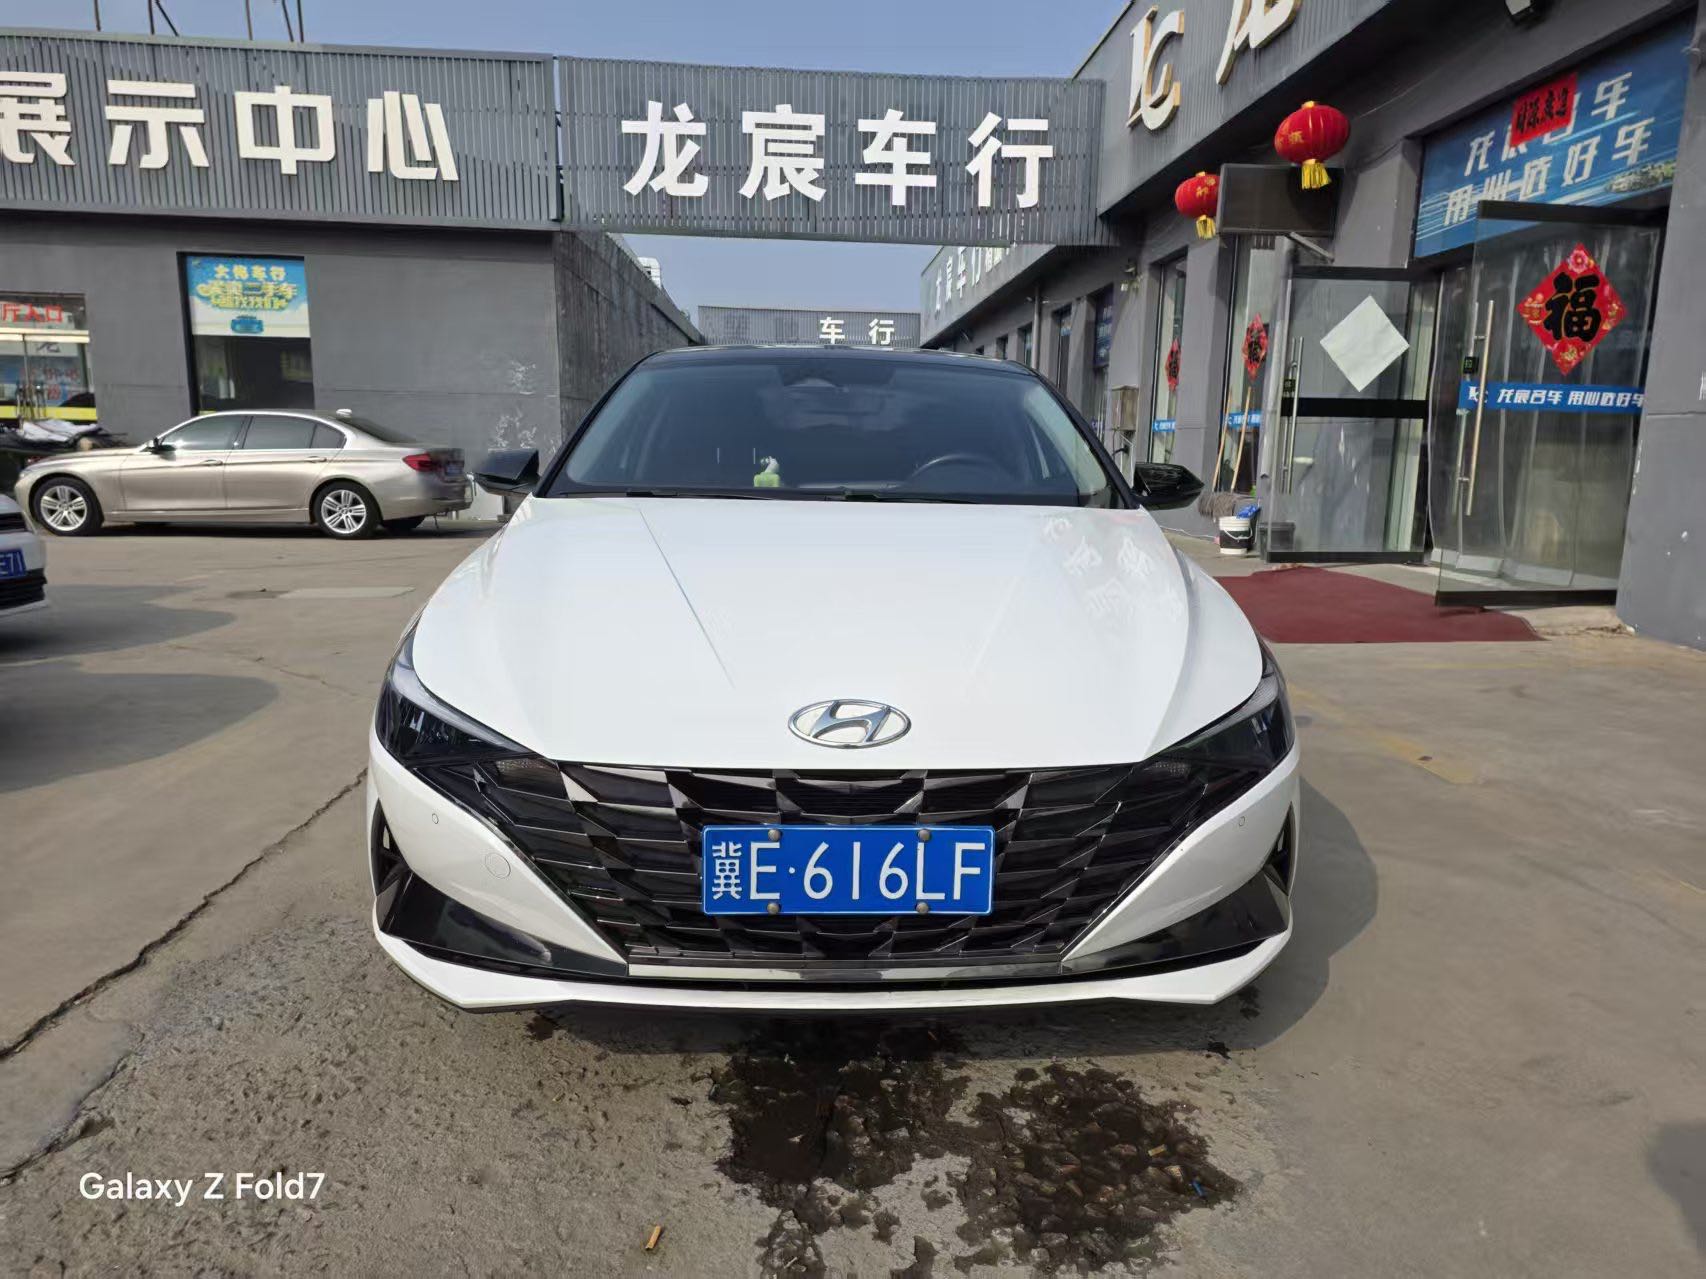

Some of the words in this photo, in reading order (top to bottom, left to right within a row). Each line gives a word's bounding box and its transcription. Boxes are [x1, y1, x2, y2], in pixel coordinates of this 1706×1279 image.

[0, 71, 458, 181] 展示中心
[621, 100, 1054, 208] 龙宸车行
[819, 316, 895, 345] 车行
[1543, 272, 1601, 342] 福
